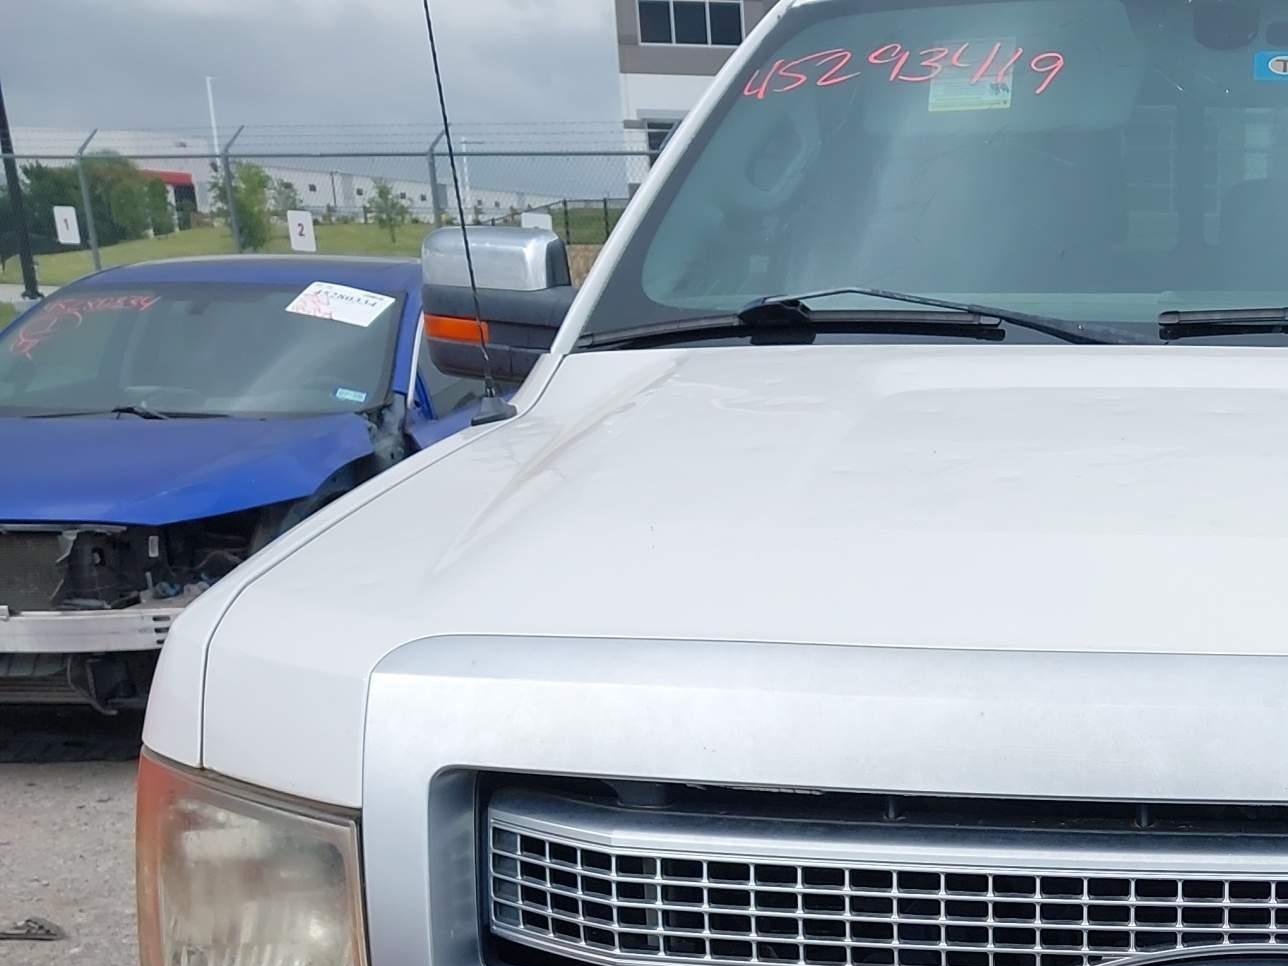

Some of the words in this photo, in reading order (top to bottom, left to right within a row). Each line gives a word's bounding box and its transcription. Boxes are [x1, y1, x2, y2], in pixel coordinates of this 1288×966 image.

[743, 42, 1065, 100] 45293419
[63, 218, 70, 231] 1
[297, 222, 305, 237] 2
